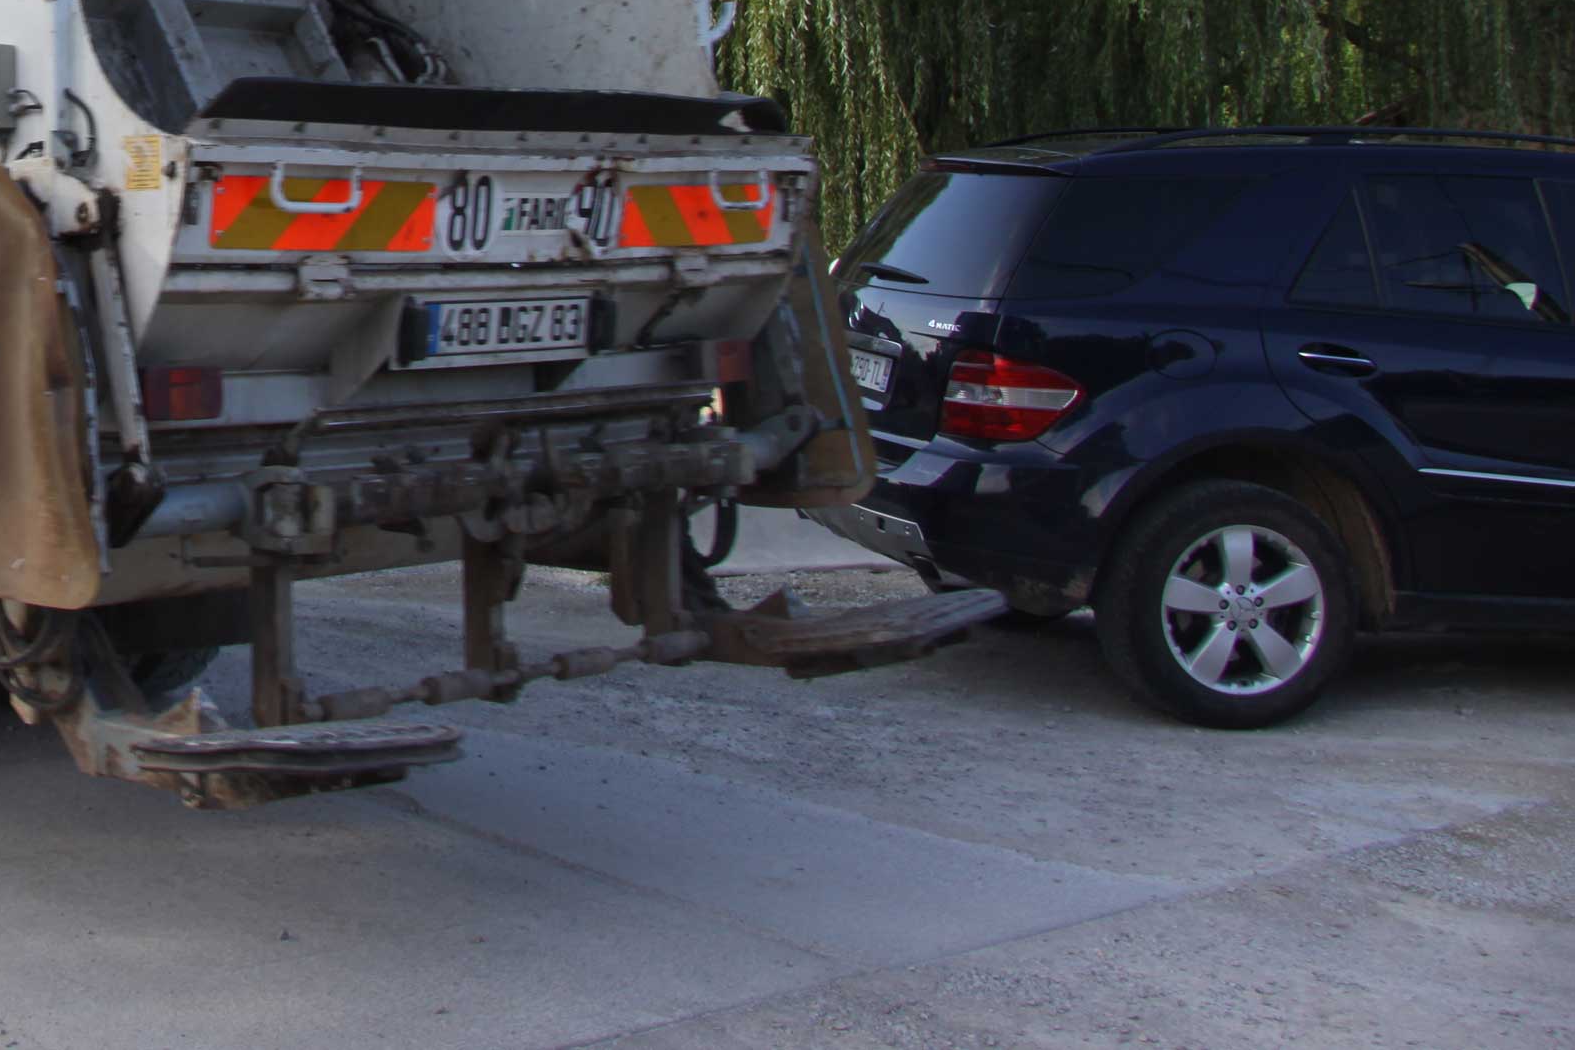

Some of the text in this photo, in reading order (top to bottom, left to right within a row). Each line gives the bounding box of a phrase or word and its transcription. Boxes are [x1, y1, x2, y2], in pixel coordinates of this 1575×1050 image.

[450, 173, 492, 251] 80
[518, 198, 568, 231] FARI
[578, 177, 614, 247] 90
[440, 307, 490, 346] 488
[550, 303, 582, 341] 83
